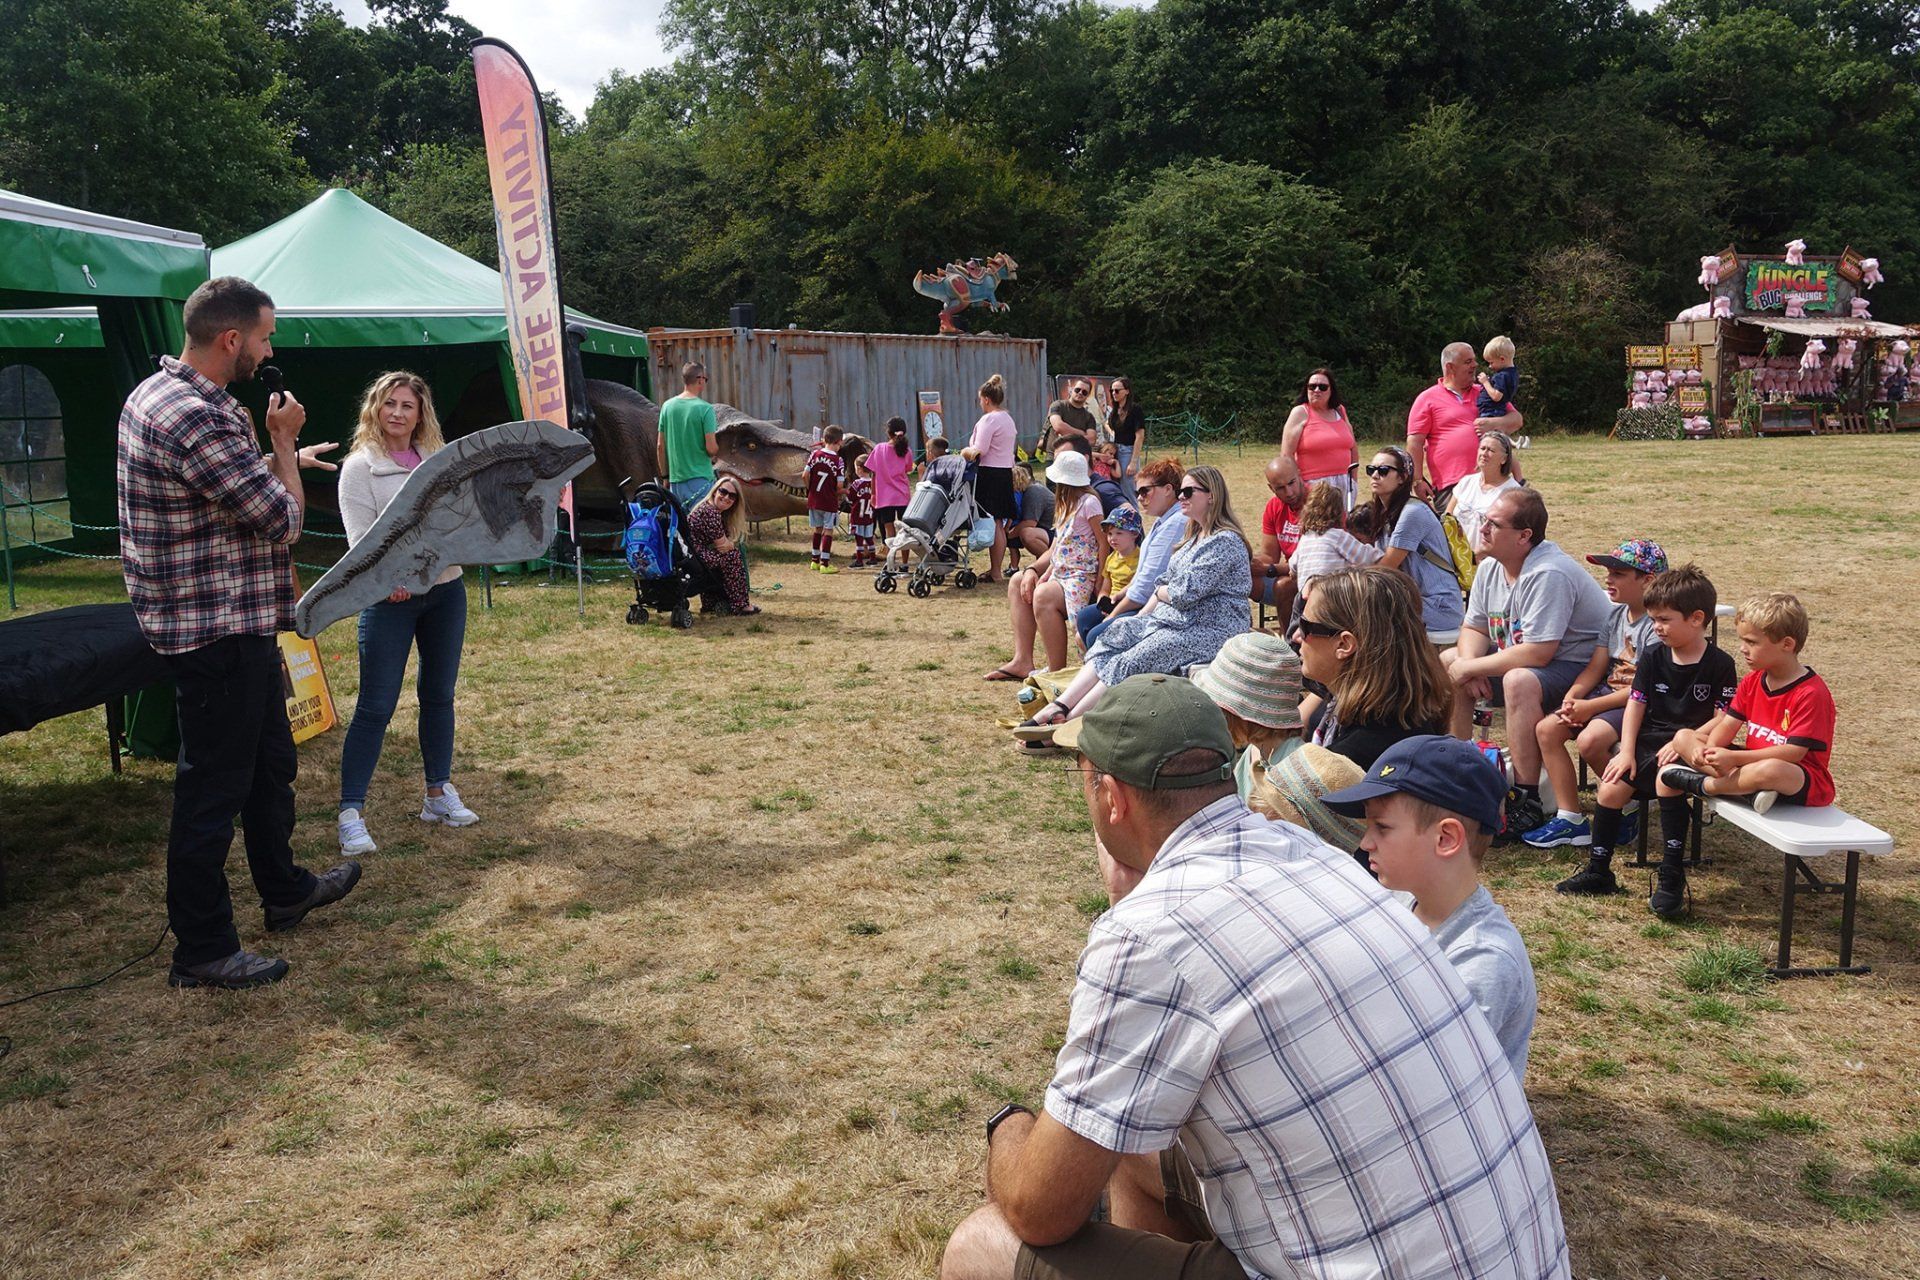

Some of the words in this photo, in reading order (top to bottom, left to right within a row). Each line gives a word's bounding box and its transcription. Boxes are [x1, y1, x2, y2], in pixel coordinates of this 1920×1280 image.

[1752, 265, 1828, 296] JUNGLE
[1758, 288, 1783, 309] BUG
[816, 470, 829, 492] 7
[859, 498, 873, 519] 14
